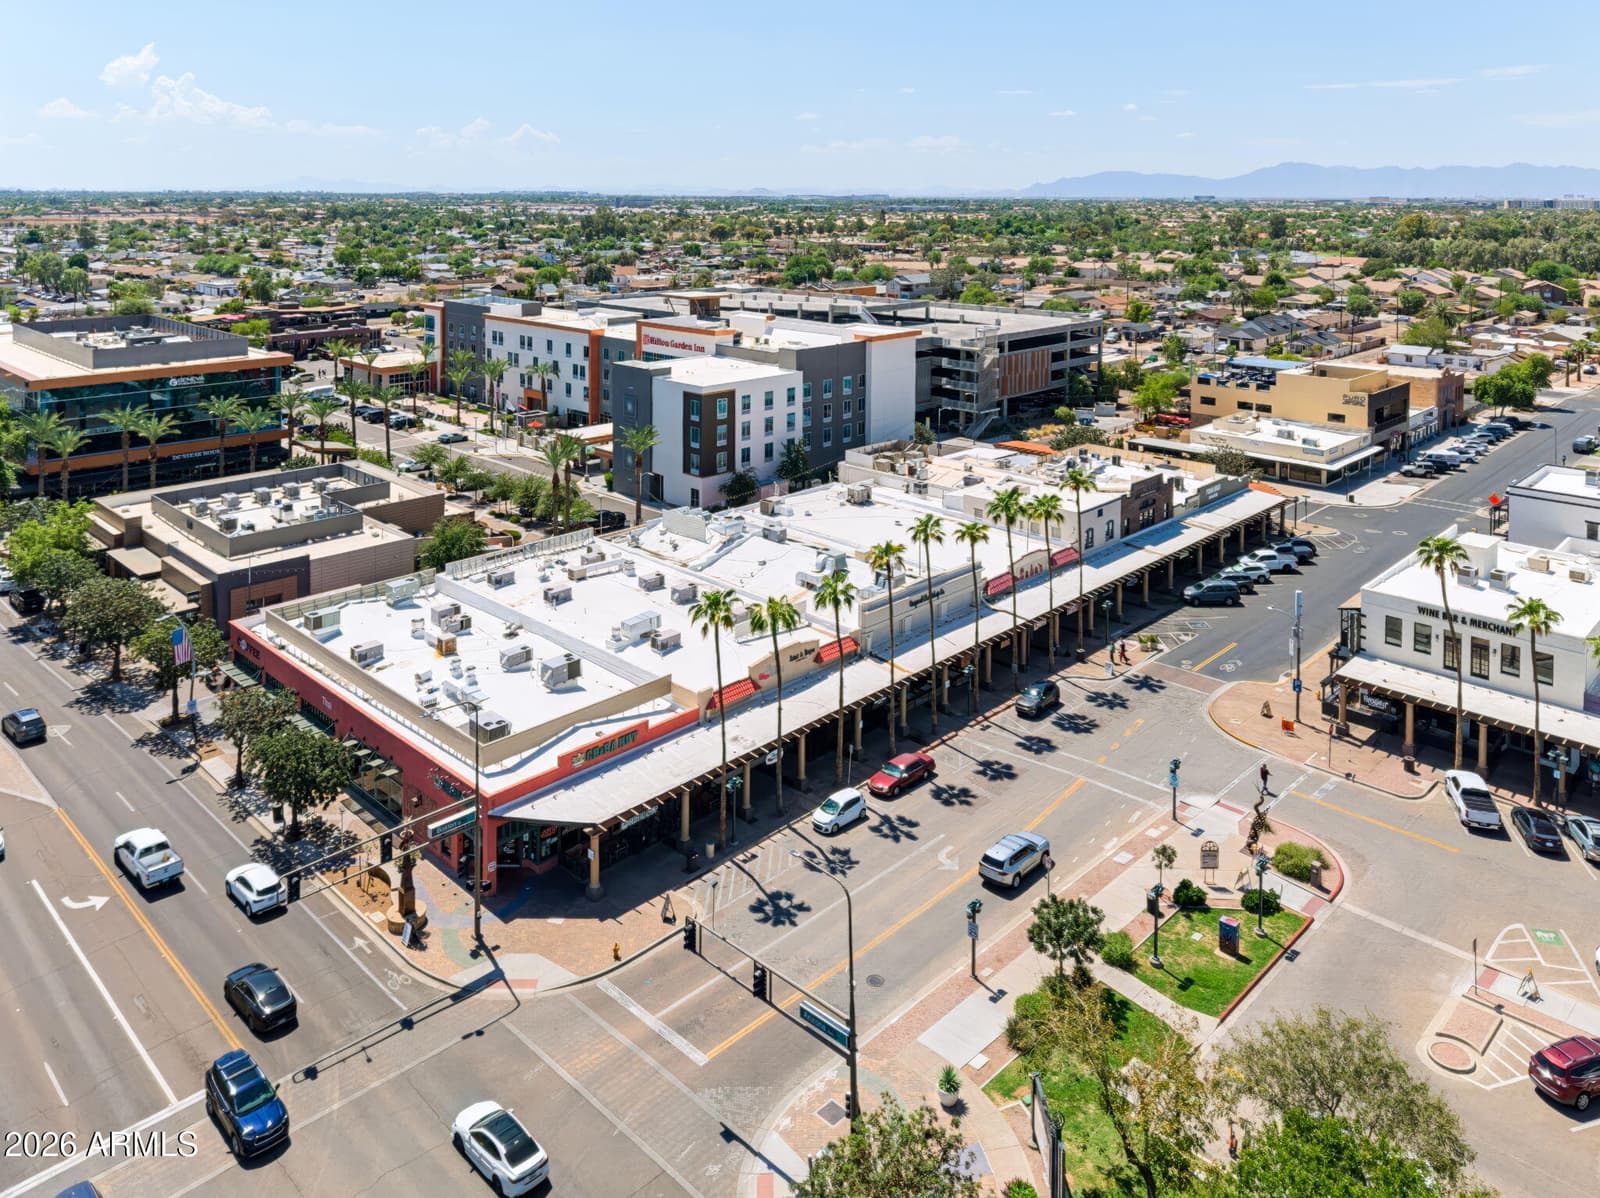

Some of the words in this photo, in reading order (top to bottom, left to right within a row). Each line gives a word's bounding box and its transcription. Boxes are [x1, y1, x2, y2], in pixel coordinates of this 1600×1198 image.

[649, 335, 669, 347] Hilton
[670, 339, 692, 350] Garden
[694, 344, 705, 353] Inn
[1417, 605, 1440, 619] WINE
[1442, 611, 1459, 623] BR
[1461, 616, 1467, 625] &
